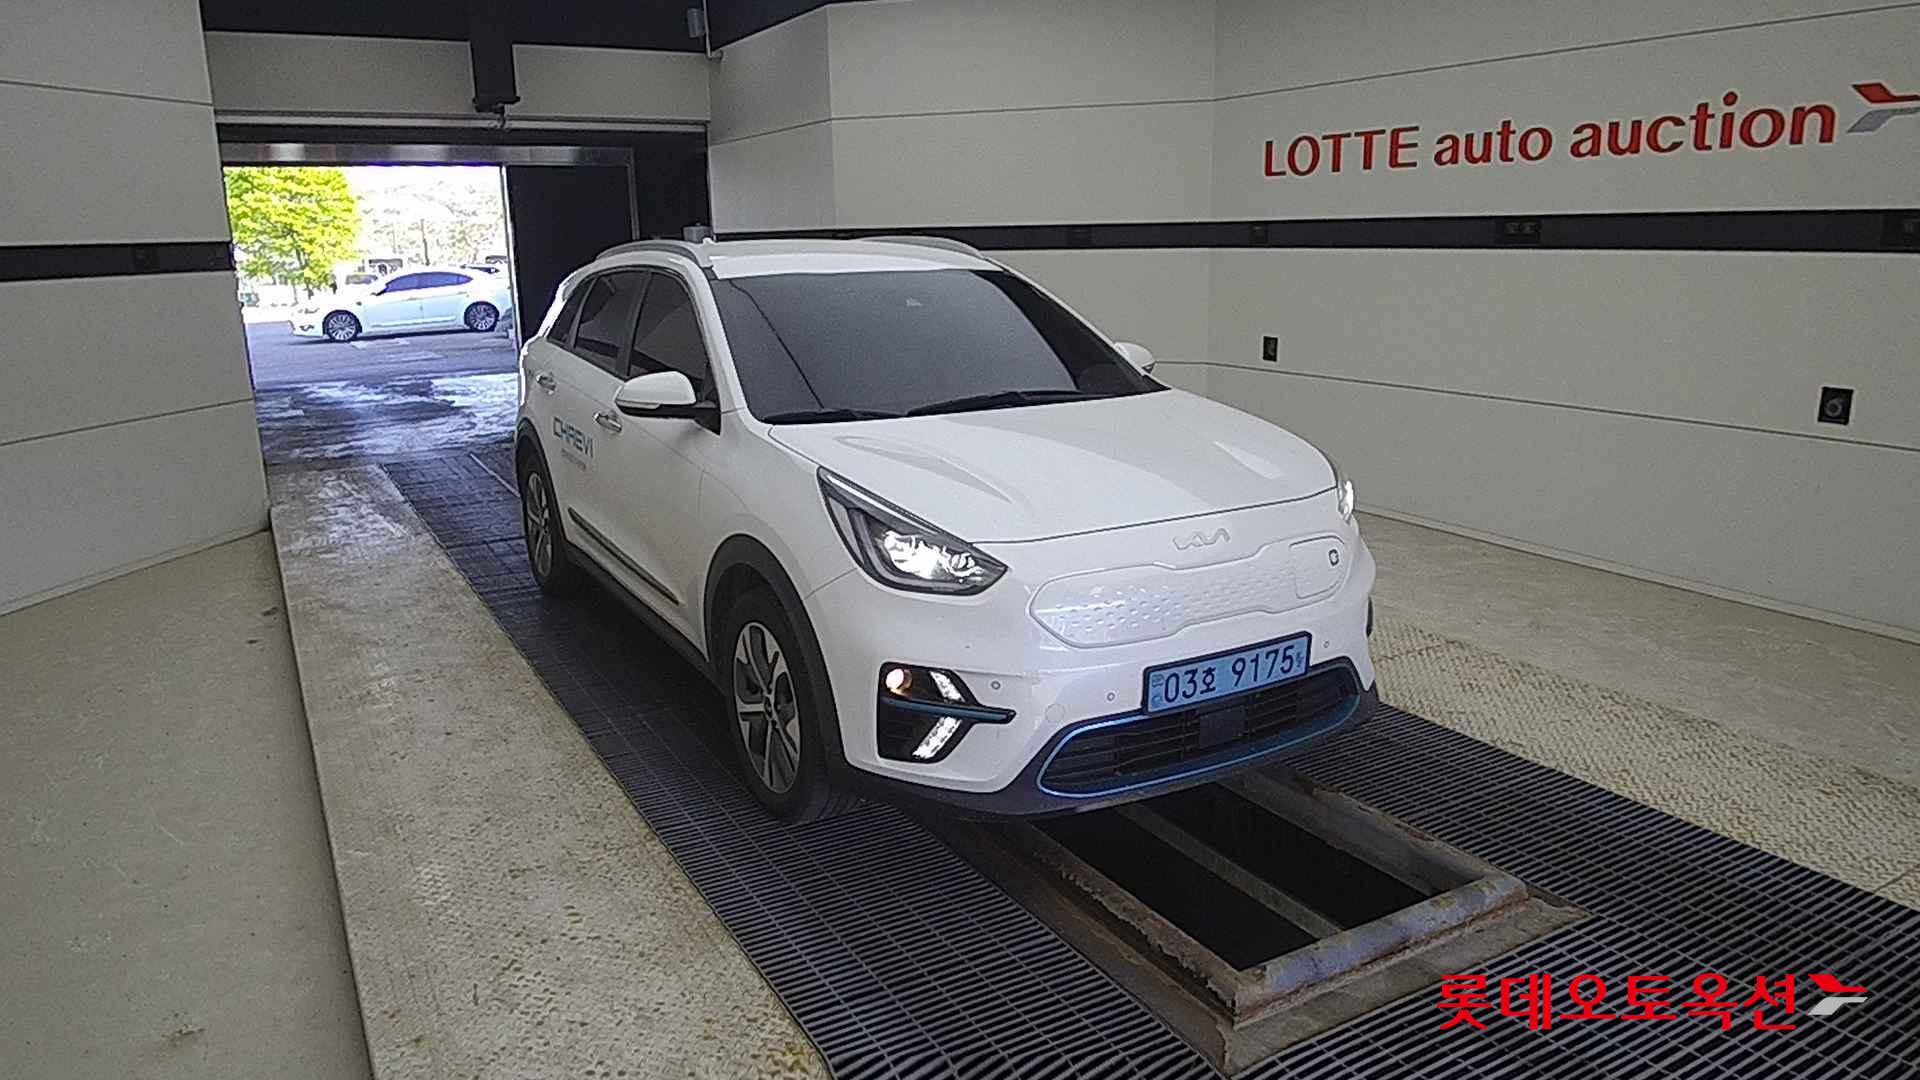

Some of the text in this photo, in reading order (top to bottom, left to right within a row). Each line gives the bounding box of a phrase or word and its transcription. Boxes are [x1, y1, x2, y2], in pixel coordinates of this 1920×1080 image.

[1264, 90, 1838, 177] LOTTE auto auction
[1163, 644, 1296, 704] 03호 9175
